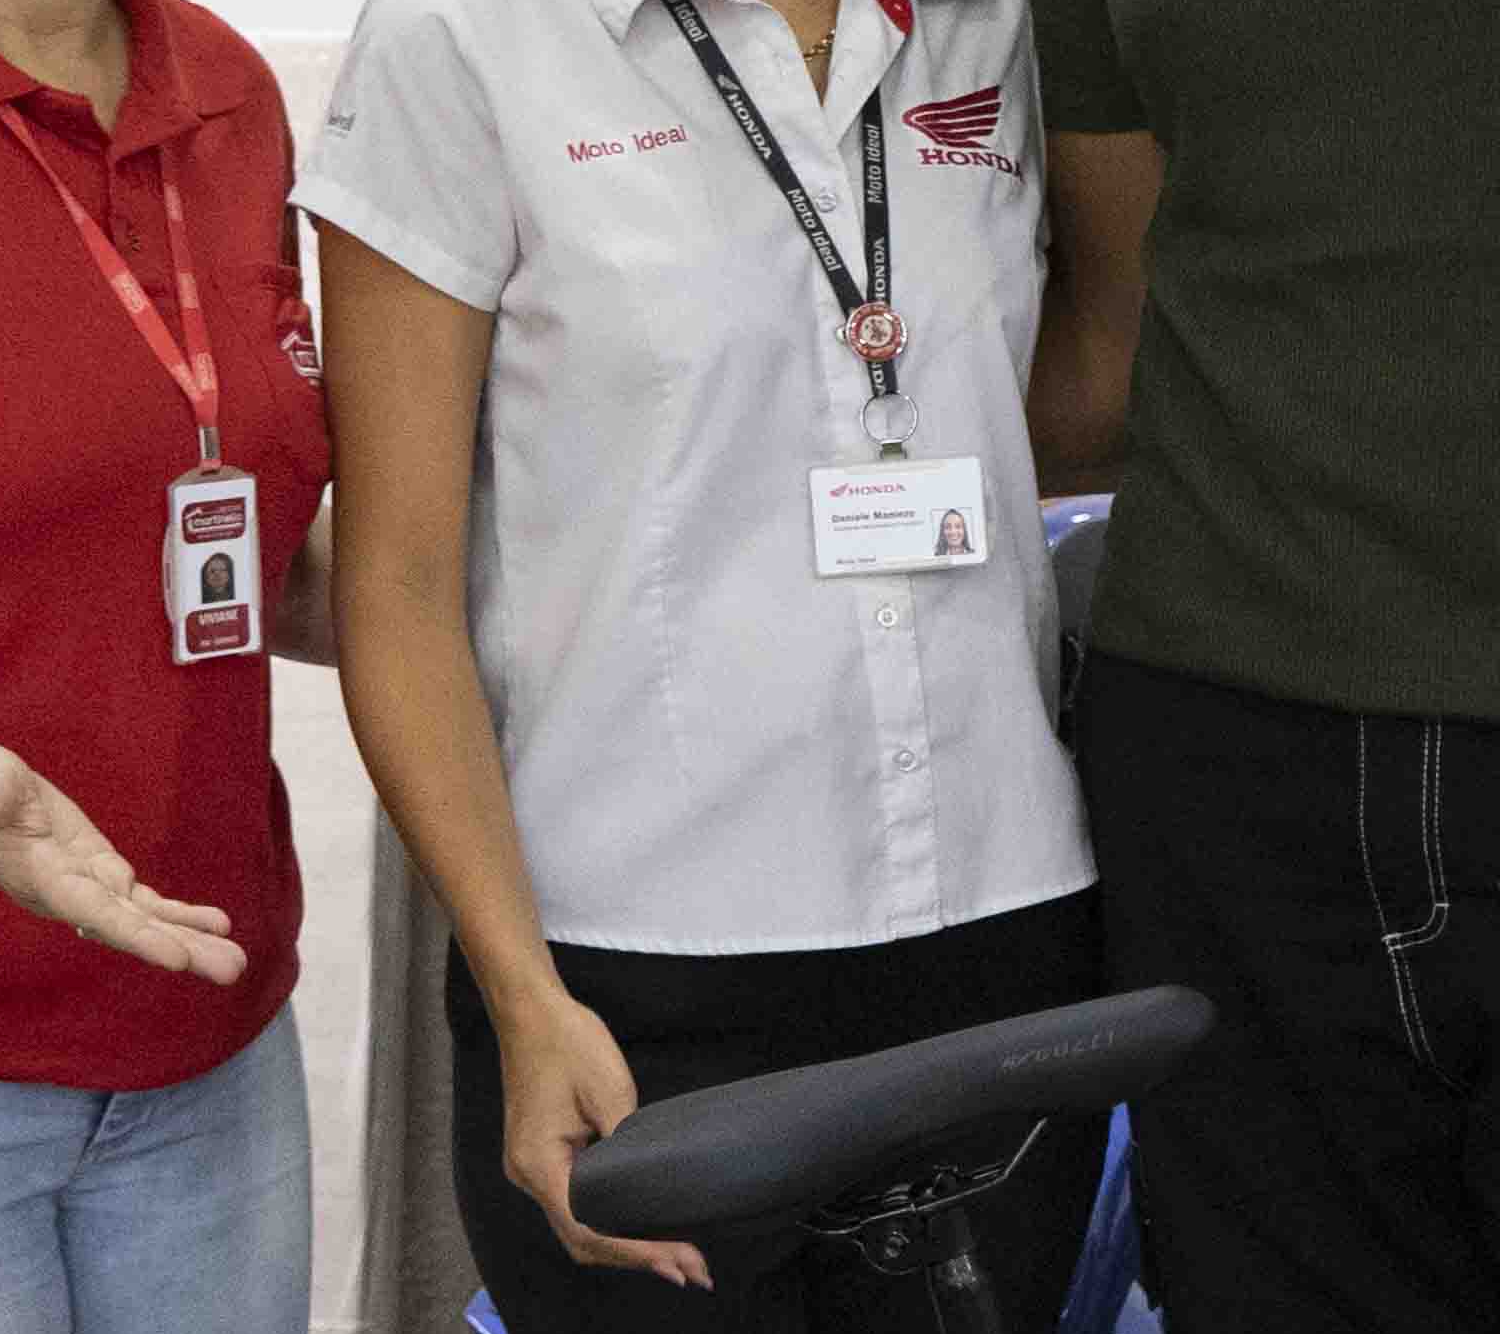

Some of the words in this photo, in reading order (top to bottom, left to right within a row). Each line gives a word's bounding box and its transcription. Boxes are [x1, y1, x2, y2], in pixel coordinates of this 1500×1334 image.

[675, 2, 710, 43] Ideal
[567, 137, 626, 164] Moto
[634, 124, 689, 156] Ideal
[724, 93, 773, 160] HONDA
[864, 123, 883, 160] Ideal
[867, 159, 885, 204] Moto
[917, 147, 1026, 186] HONDA
[787, 188, 817, 230] Moto
[812, 229, 844, 273] Ideal
[848, 482, 908, 497] HONDA
